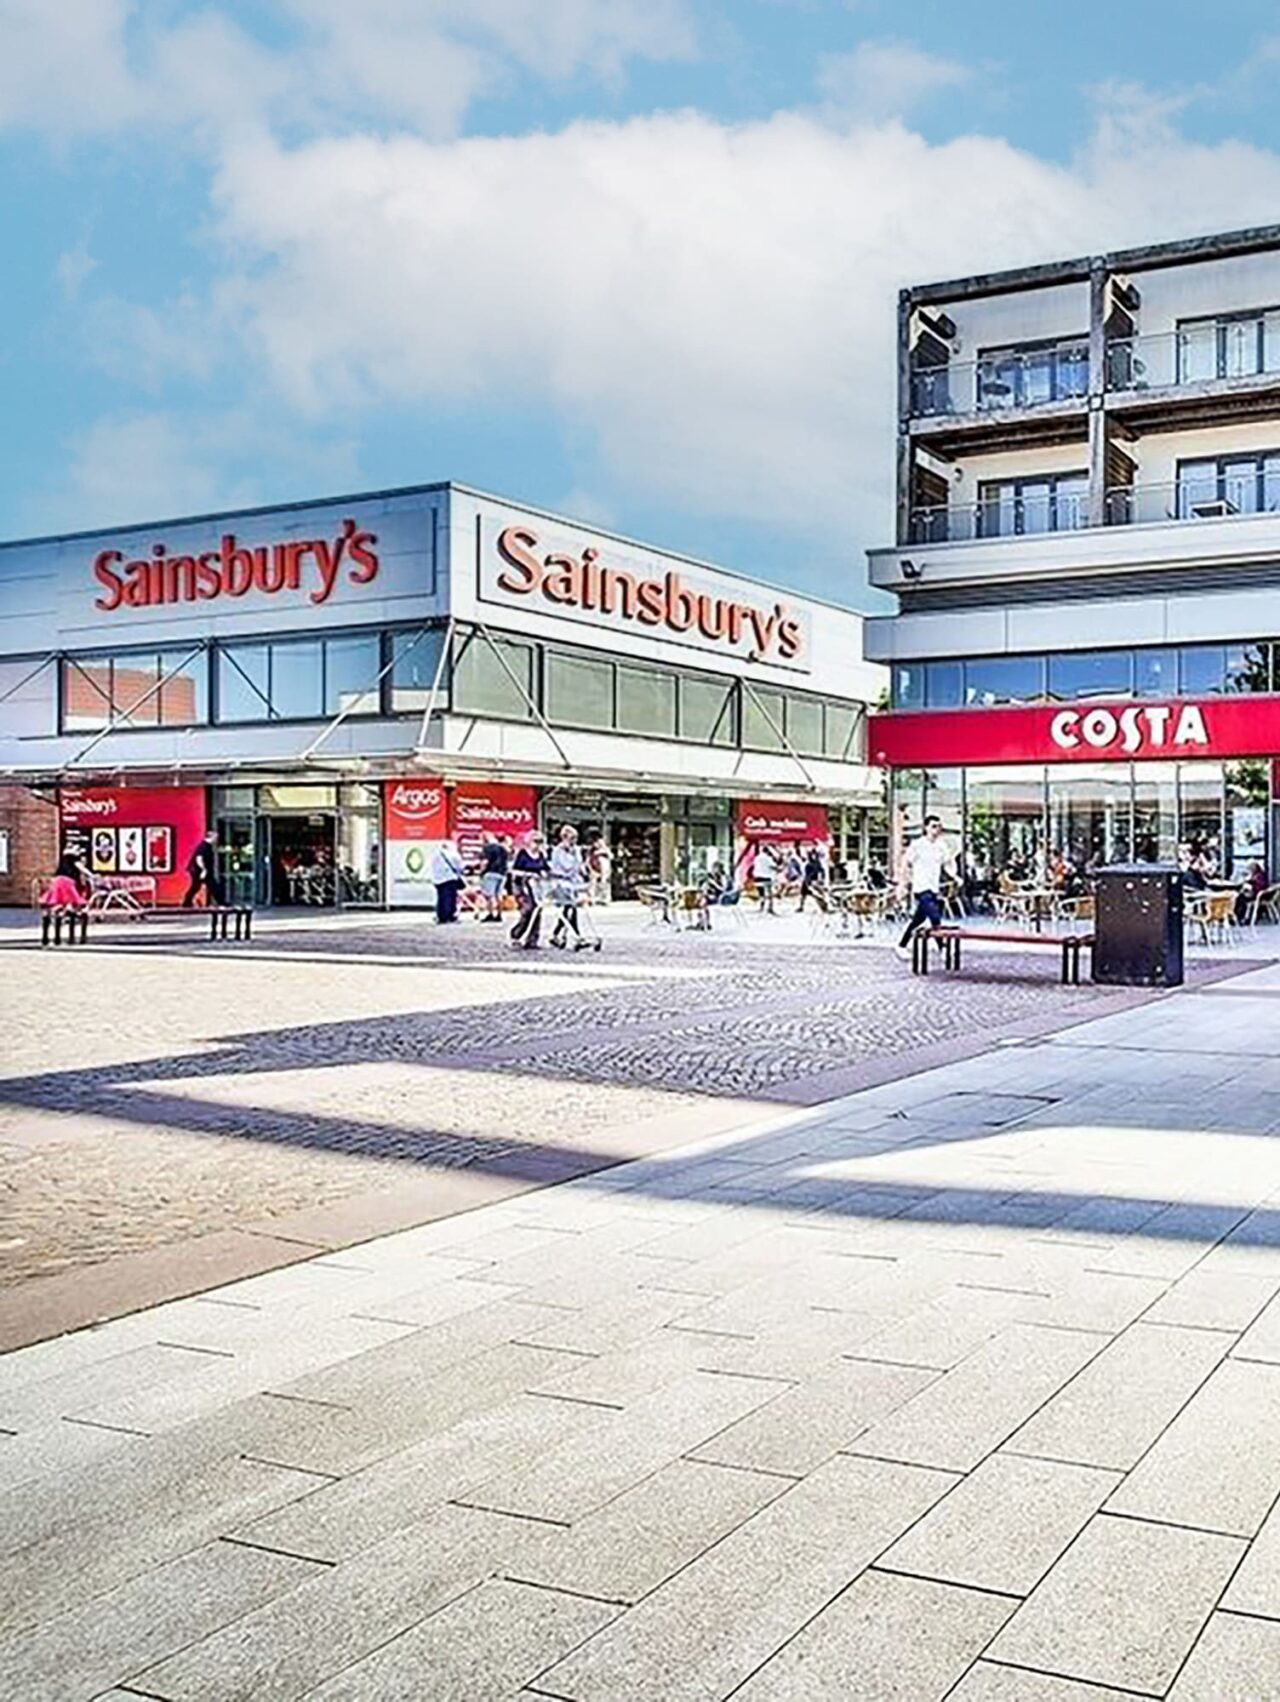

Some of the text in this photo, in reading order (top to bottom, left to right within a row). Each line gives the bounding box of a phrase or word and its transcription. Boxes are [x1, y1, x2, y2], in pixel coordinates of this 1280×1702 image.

[94, 518, 380, 611] Sainsbury's
[496, 525, 804, 660] Sainsbury's
[1050, 705, 1209, 752] COSTA
[391, 785, 441, 809] Argos
[455, 804, 533, 824] Sainsbury's
